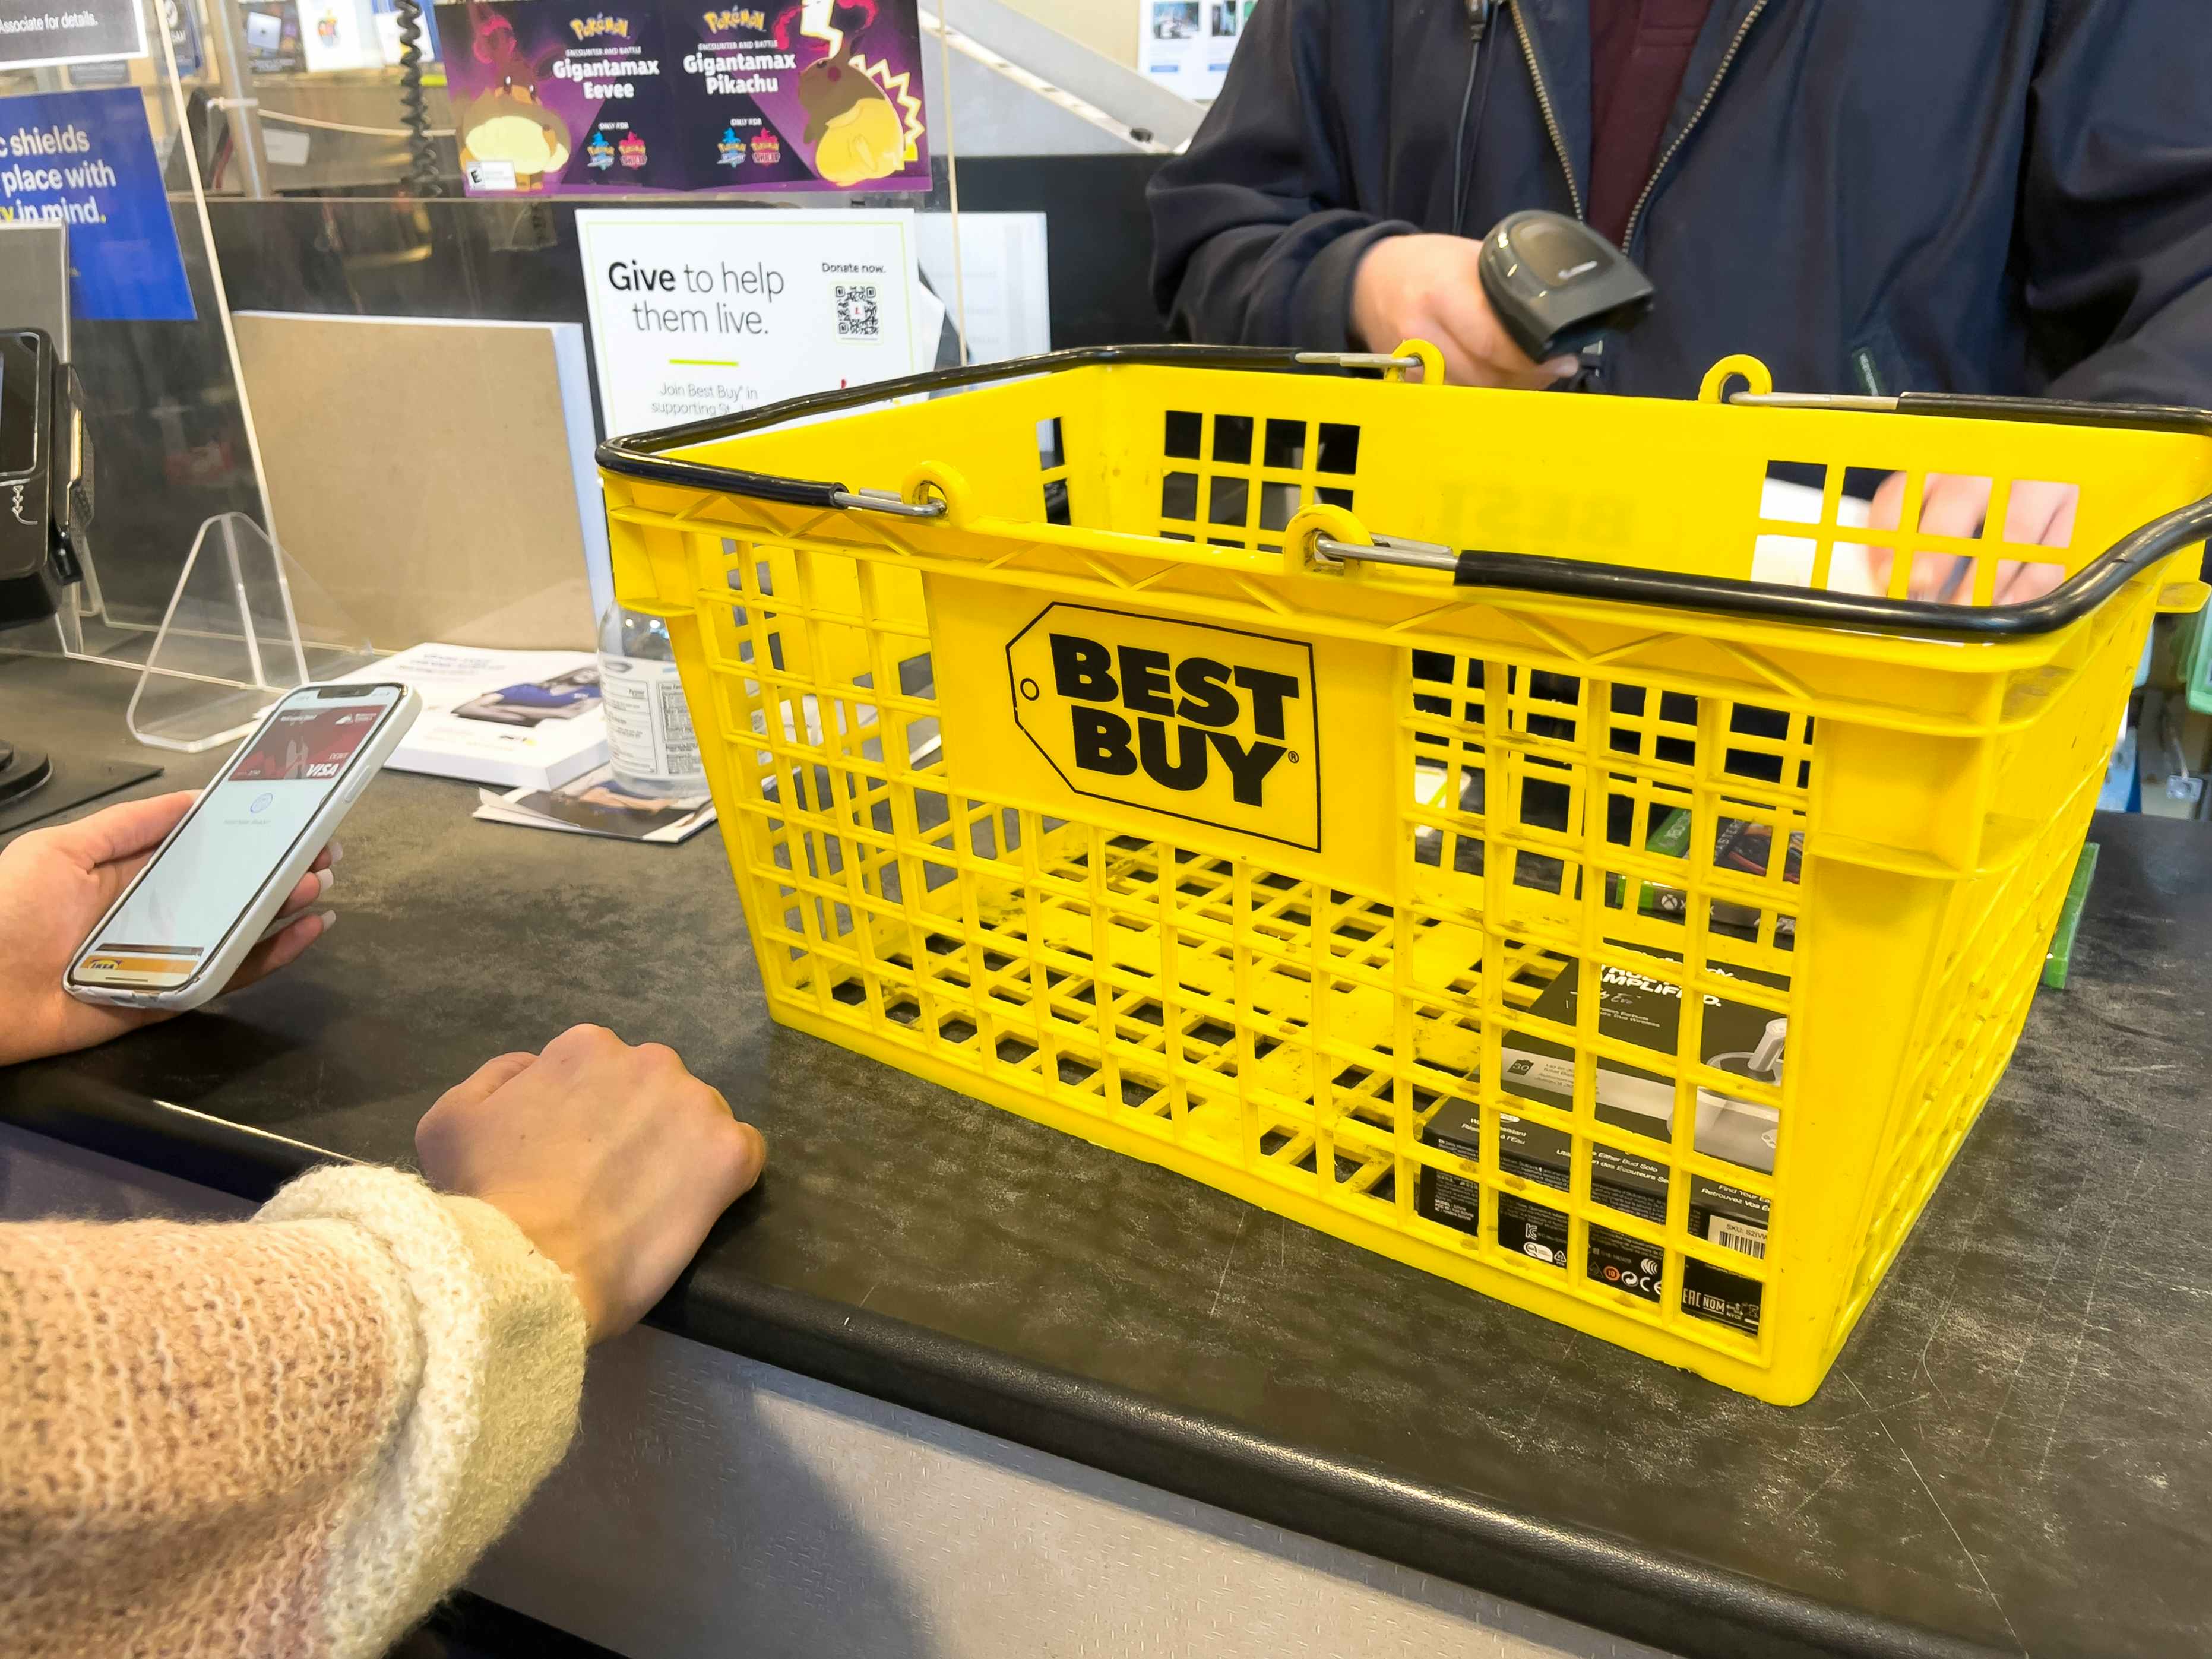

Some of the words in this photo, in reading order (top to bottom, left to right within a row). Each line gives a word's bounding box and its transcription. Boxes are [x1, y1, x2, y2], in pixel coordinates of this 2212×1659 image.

[45, 13, 59, 29] for
[61, 10, 99, 28] details.
[553, 58, 659, 82] Gigantamax
[683, 52, 796, 75] Gigantamax
[583, 81, 634, 99] Eevee
[706, 74, 778, 95] Pikachu
[10, 124, 90, 157] shields
[1, 164, 63, 198] place
[65, 159, 116, 188] with
[42, 196, 106, 223] mind.
[822, 262, 859, 273] Donate
[862, 264, 887, 274] now.
[609, 259, 676, 292] Give
[684, 264, 713, 293] to
[721, 261, 784, 303] help
[633, 300, 708, 333] them
[717, 302, 768, 334] live.
[660, 382, 685, 397] Join
[688, 384, 714, 398] Best
[746, 386, 758, 400] in
[651, 401, 717, 417] supporting
[1049, 633, 1299, 741] BEST
[306, 763, 340, 777] VISA
[1599, 1152, 1621, 1163] Either
[1622, 1158, 1638, 1168] Bud
[1640, 1161, 1658, 1172] Solo
[1603, 1161, 1615, 1170] des
[1616, 1164, 1656, 1182] Écouteurs
[1701, 1188, 1742, 1204] Retrouvez
[1745, 1199, 1760, 1210] Vos
[1718, 1184, 1737, 1195] Find
[1739, 1190, 1757, 1199] Your
[1727, 1223, 1745, 1236] SKU:
[1702, 1296, 1724, 1313] NOM
